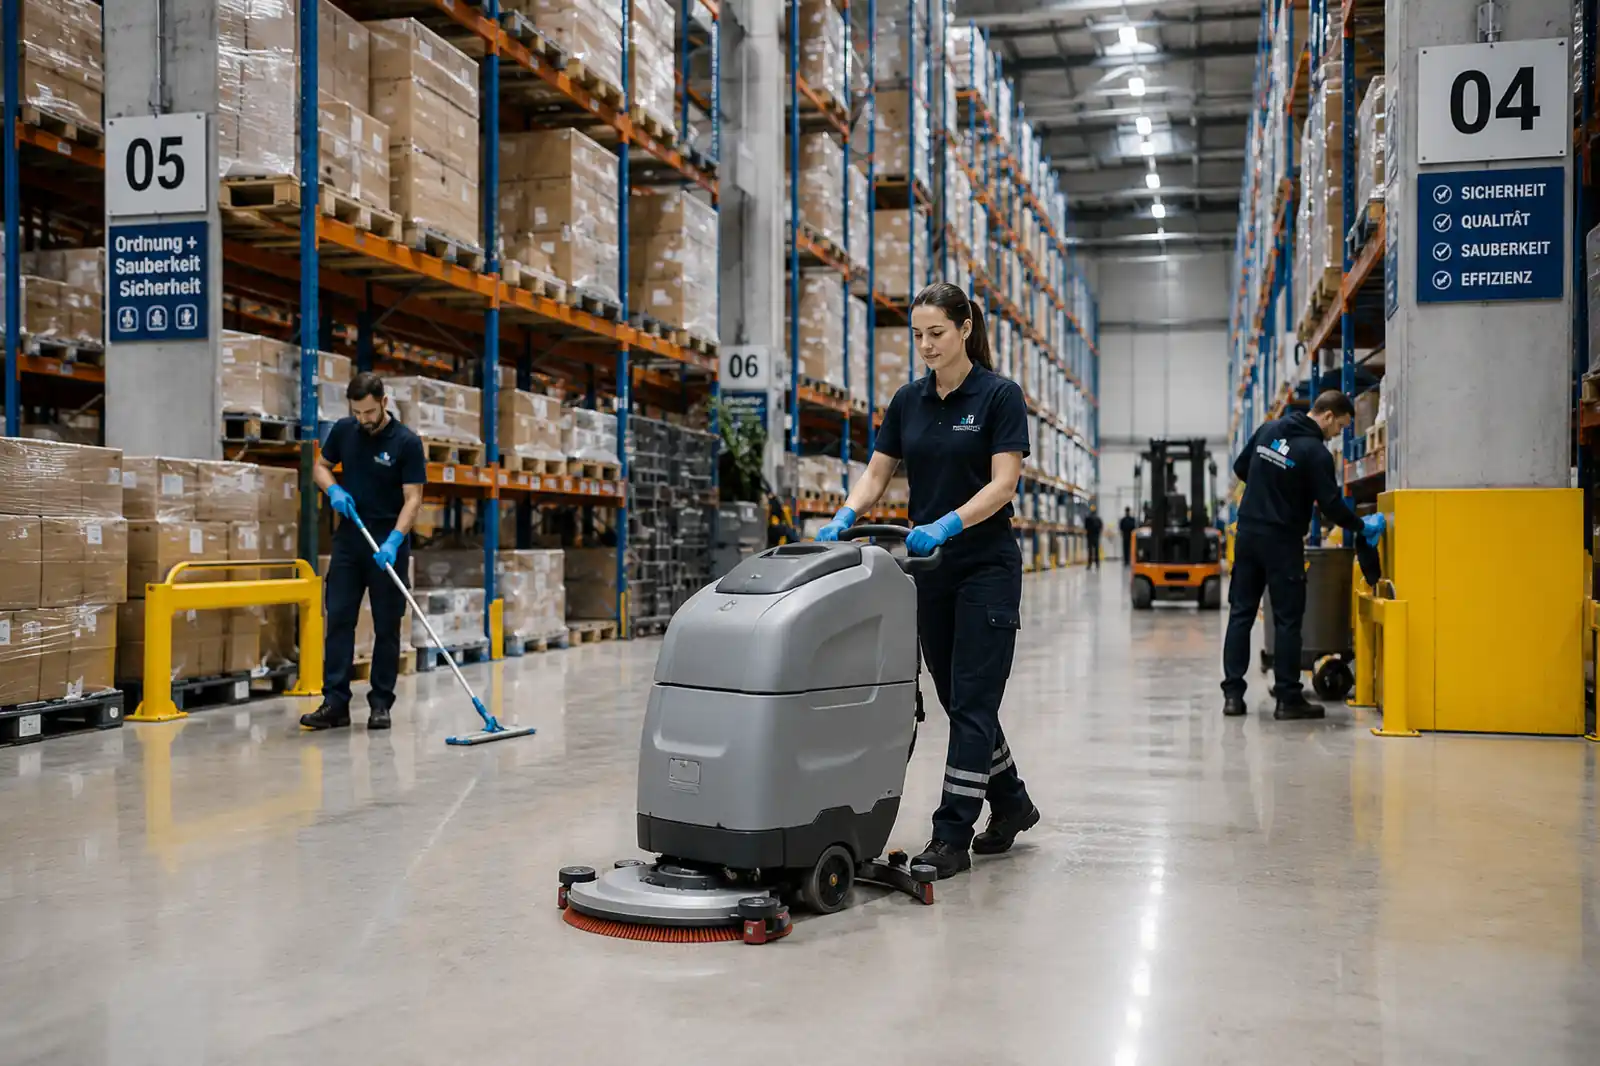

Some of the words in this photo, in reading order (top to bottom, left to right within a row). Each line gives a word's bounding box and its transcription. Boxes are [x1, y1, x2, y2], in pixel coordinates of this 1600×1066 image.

[1451, 66, 1541, 135] 04
[126, 136, 185, 192] 05
[1461, 183, 1547, 200] SICHERHEIT
[115, 236, 183, 253] Ordnung
[186, 236, 198, 250] +
[1461, 241, 1551, 258] SAUBERKEIT
[115, 255, 201, 275] Sauberkeit
[119, 277, 202, 298] Sicherheit
[1461, 270, 1533, 286] EFFIZIENZ
[729, 354, 759, 379] 06
